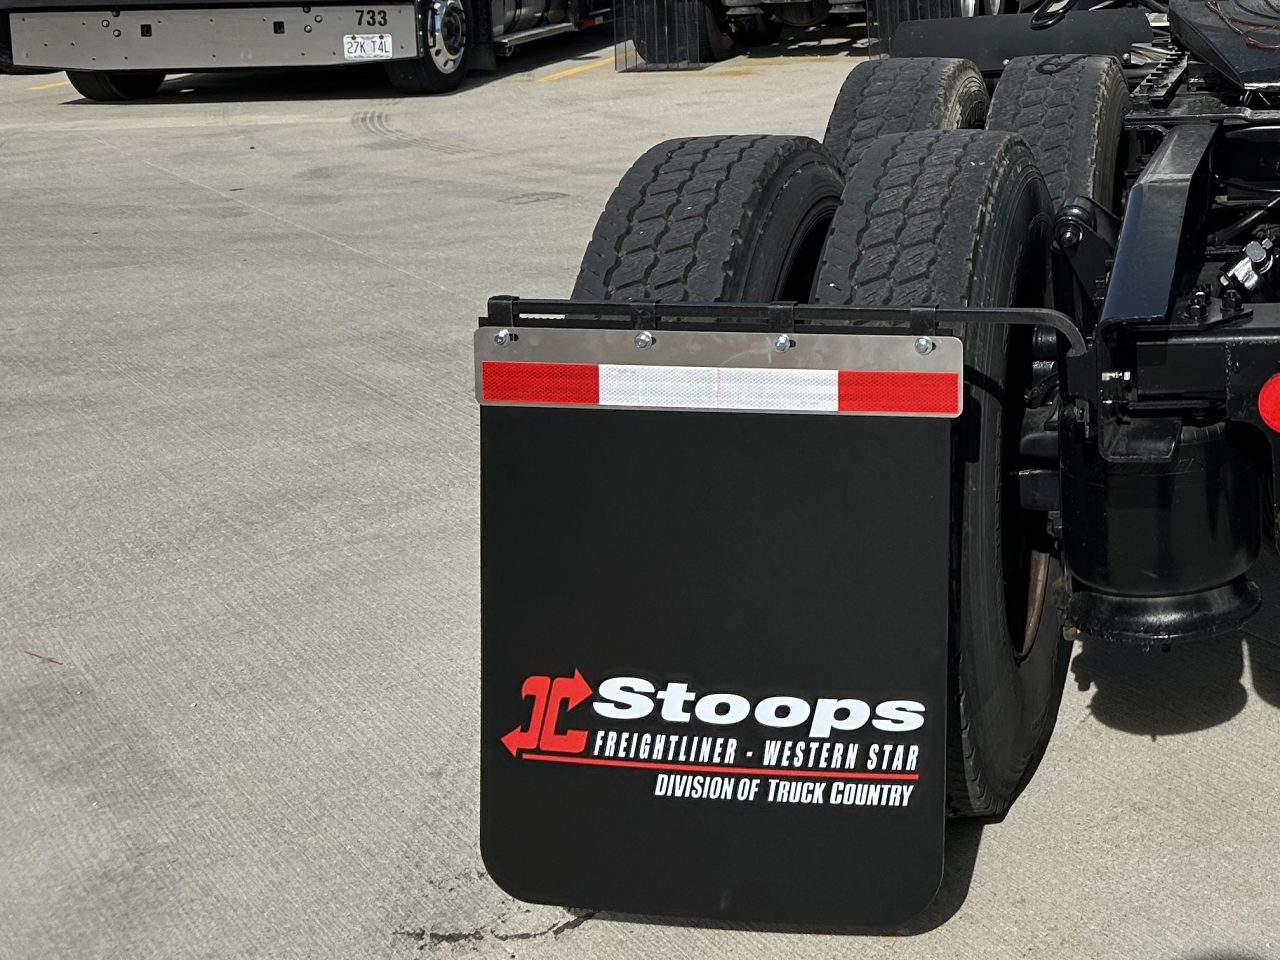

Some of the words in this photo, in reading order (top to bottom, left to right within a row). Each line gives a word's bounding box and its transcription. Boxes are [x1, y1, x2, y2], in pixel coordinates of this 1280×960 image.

[355, 10, 388, 26] 733
[347, 41, 367, 54] 27K
[593, 677, 925, 738] Stoops
[594, 731, 737, 764] FREIGHTLINER
[763, 740, 858, 769] WESTERN
[866, 744, 919, 771] STAR
[655, 774, 735, 800] DIVISION
[737, 778, 760, 800] OF
[768, 779, 826, 804] TRUCK
[830, 782, 914, 807] COUNTRY
